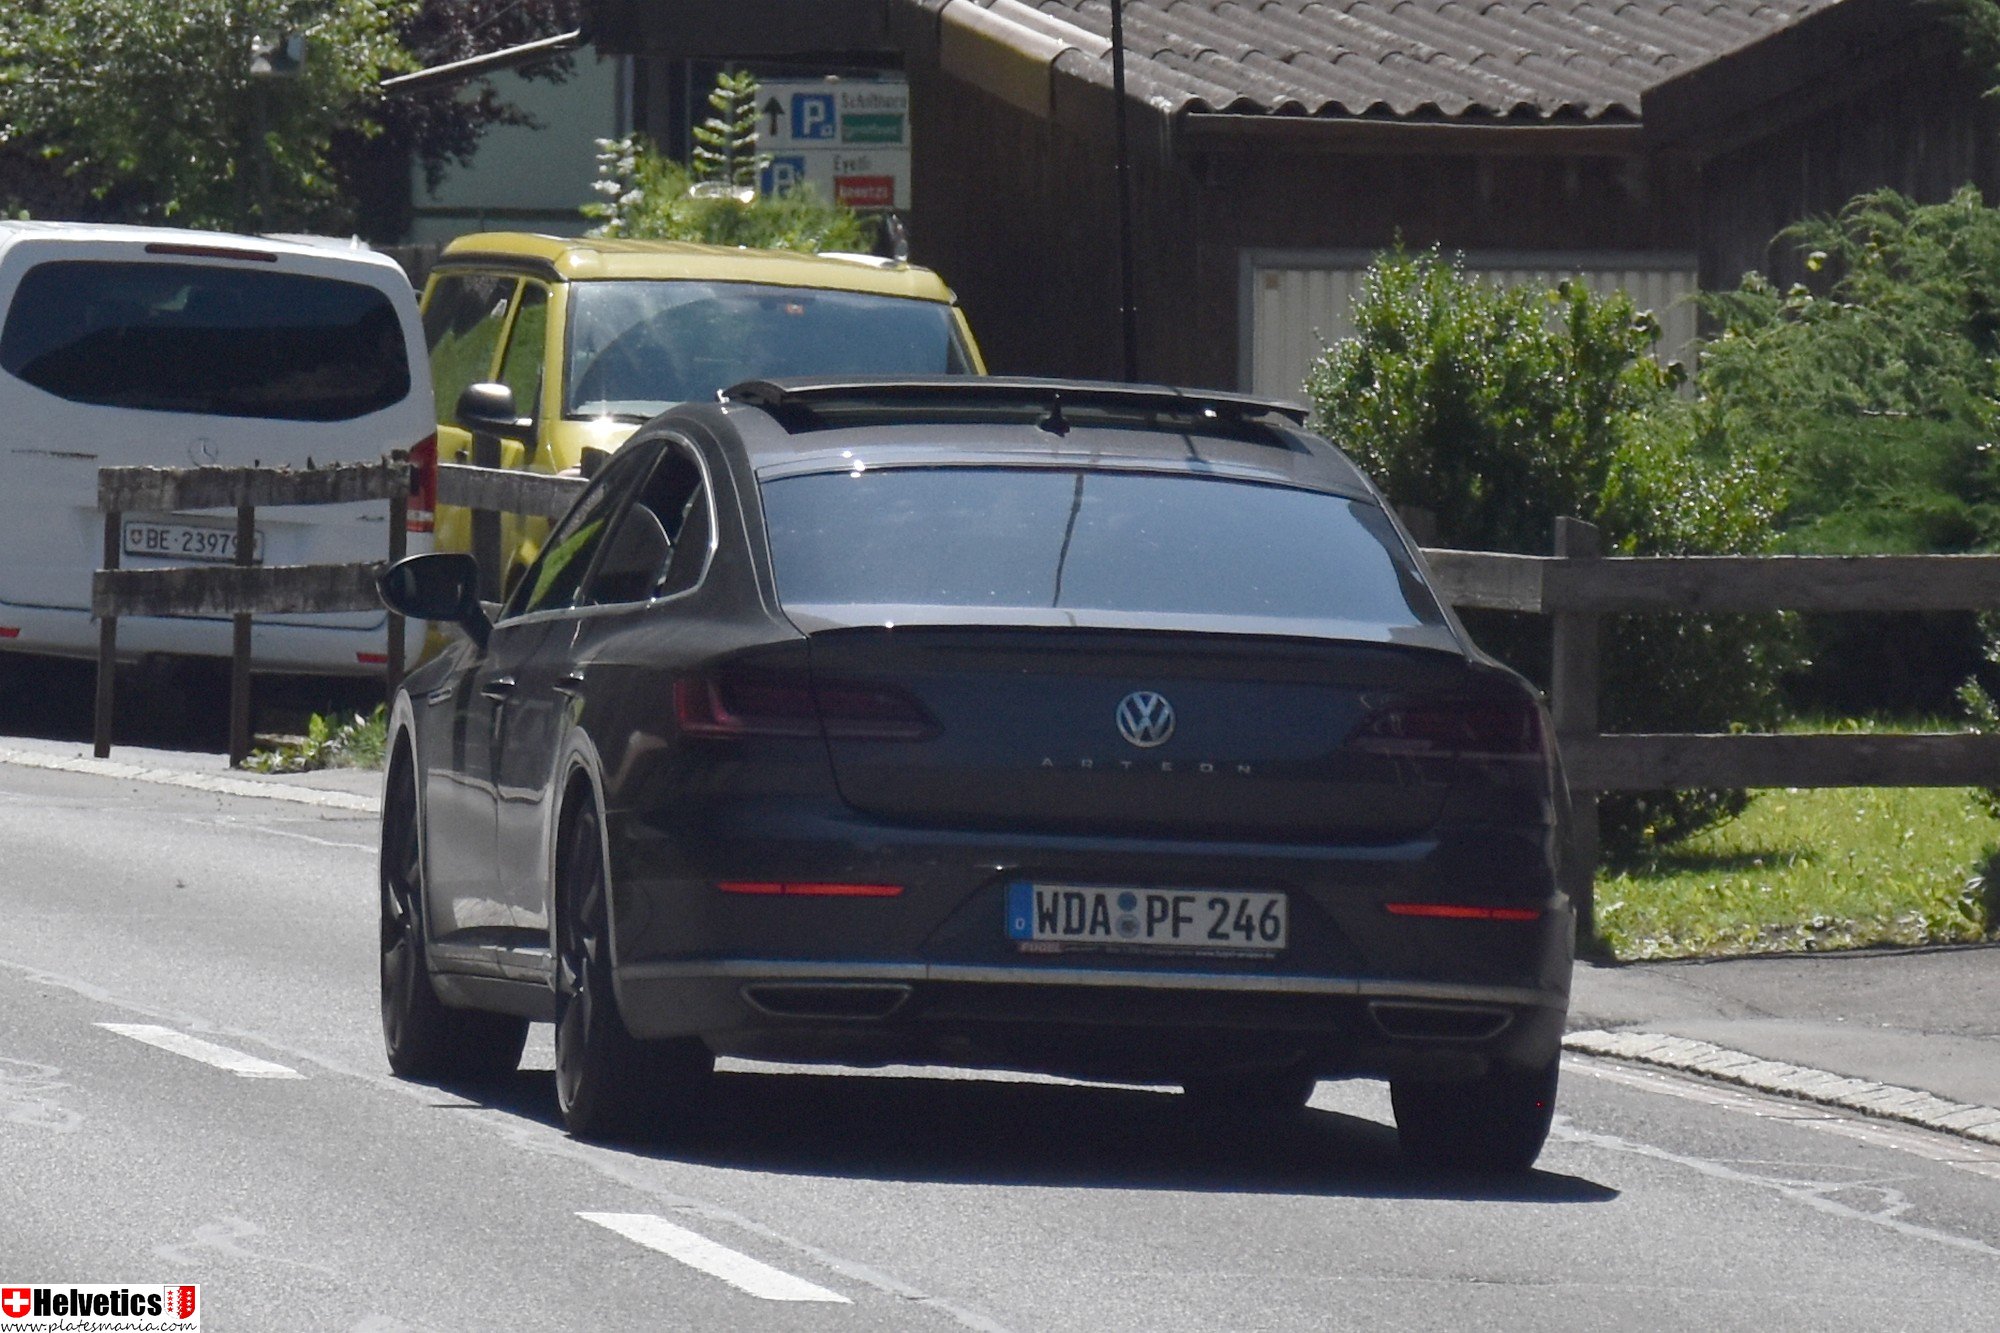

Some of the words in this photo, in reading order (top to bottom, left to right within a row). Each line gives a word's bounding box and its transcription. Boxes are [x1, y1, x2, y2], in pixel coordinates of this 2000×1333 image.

[803, 100, 826, 135] P
[1042, 757, 1250, 774] ARTEON
[1036, 891, 1111, 935] WDA
[1146, 895, 1196, 938] PF
[1207, 897, 1281, 941] 246
